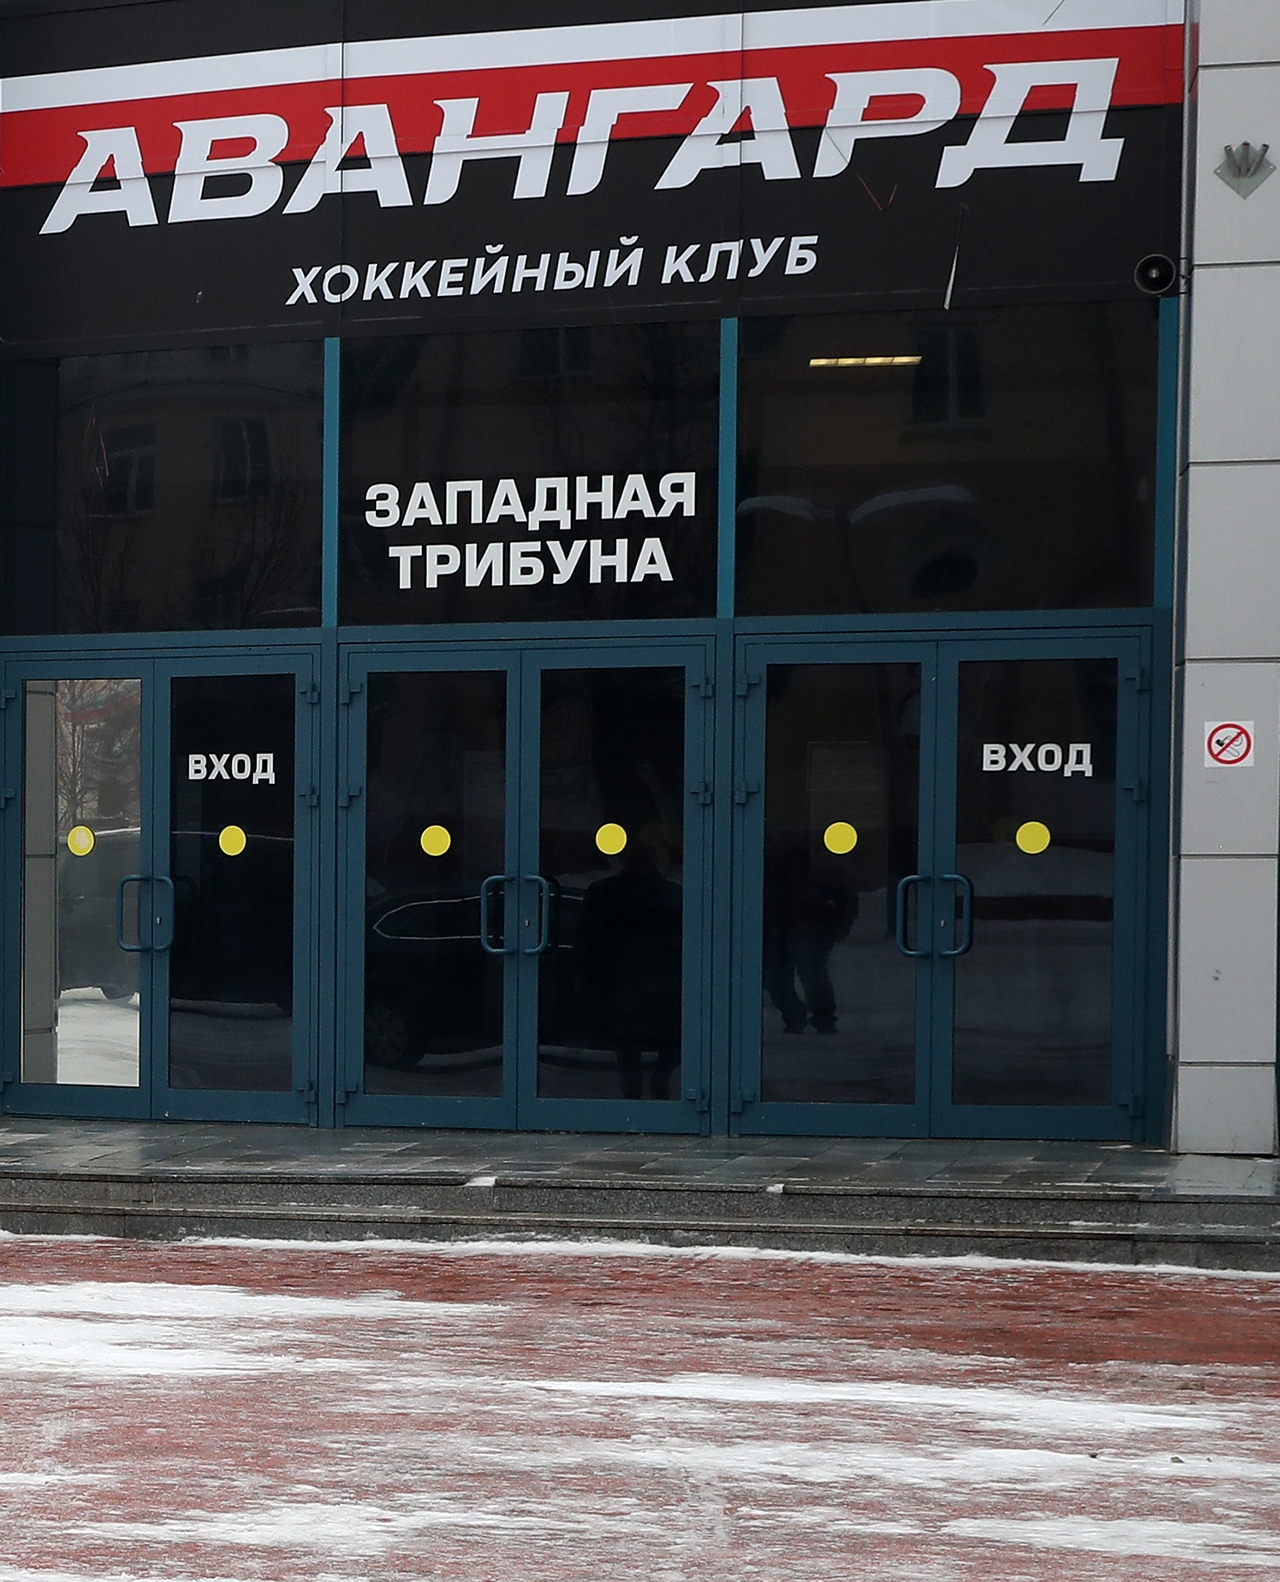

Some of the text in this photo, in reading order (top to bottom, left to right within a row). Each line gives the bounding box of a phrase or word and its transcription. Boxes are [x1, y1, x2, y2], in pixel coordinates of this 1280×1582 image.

[38, 57, 1125, 234] АВАНГАРД
[285, 235, 819, 306] ХОККЕЙНЫЙ КЛУБ
[365, 471, 696, 531] ЗАПАДНАЯ
[388, 537, 674, 590] ТРИБУНА
[188, 752, 276, 785] ВХОД
[982, 743, 1093, 777] ВХОД
